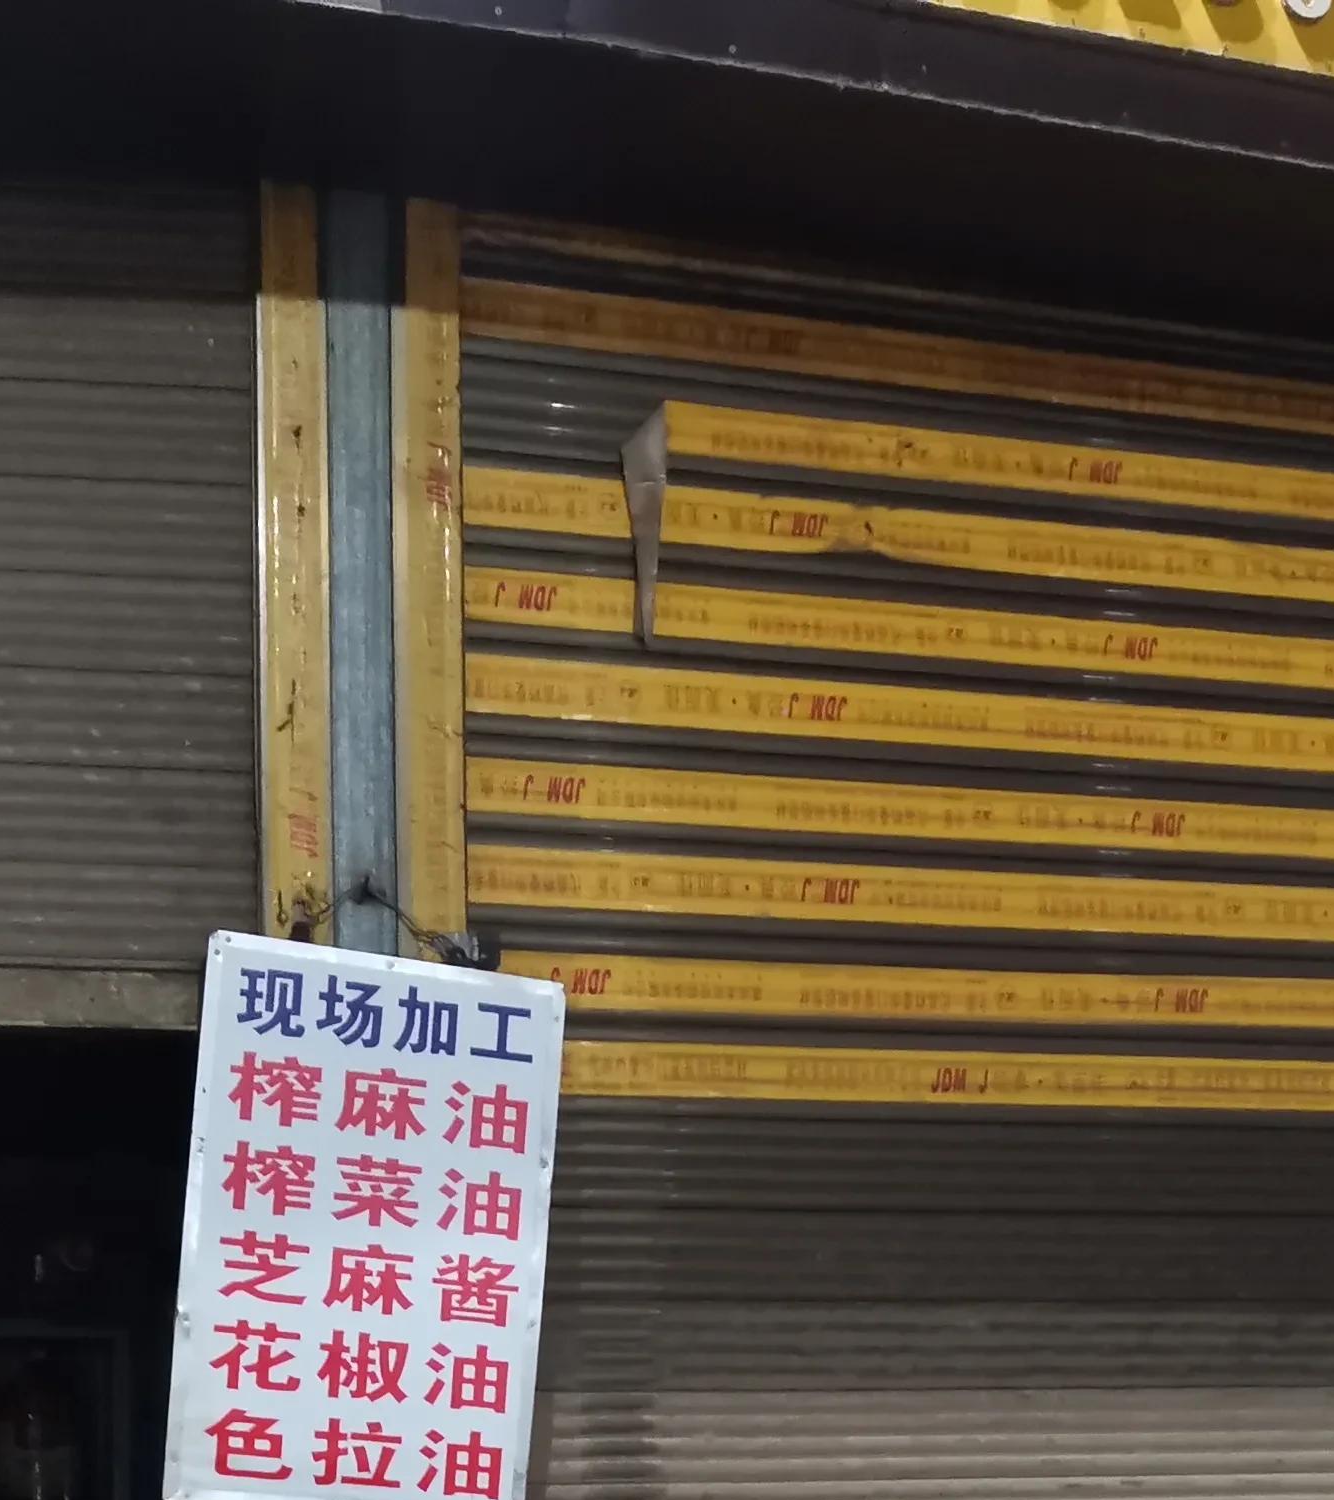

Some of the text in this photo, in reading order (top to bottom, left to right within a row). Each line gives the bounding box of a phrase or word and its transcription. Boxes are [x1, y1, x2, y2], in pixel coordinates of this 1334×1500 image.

[237, 967, 533, 1063] 现场加工
[228, 1050, 531, 1154] 榨麻油
[222, 1140, 523, 1242] 榨菜油
[218, 1230, 519, 1328] 芝麻酱
[209, 1320, 510, 1414] 花椒油
[204, 1409, 504, 1500] 色拉油
